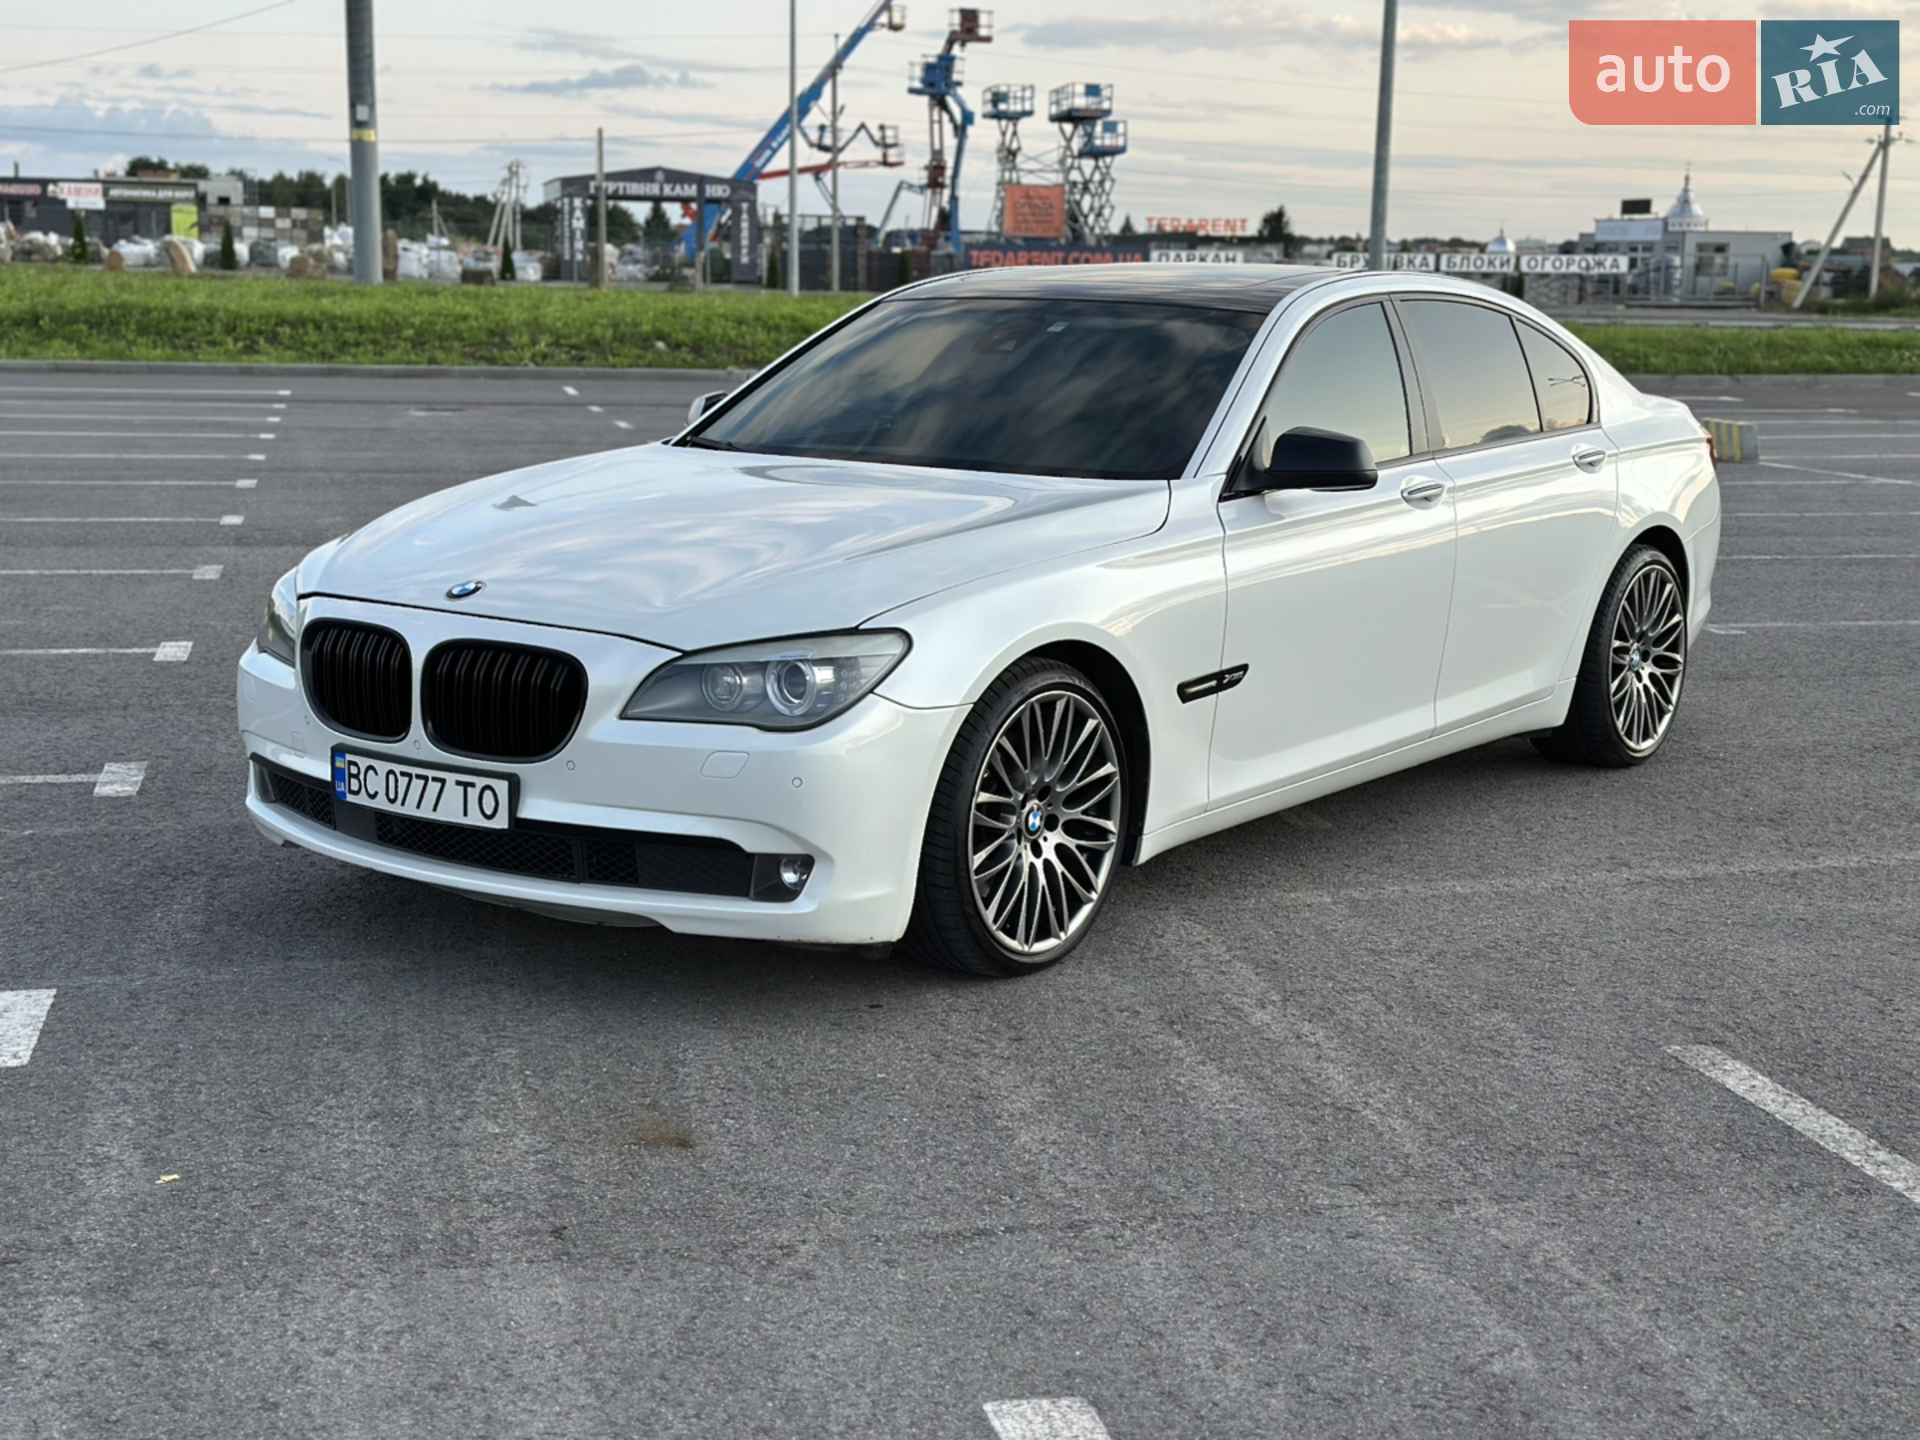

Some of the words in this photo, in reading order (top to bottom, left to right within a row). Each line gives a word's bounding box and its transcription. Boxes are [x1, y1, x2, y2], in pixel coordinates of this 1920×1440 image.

[663, 183, 731, 198] КАМНЮ
[1445, 256, 1512, 270] БЛОКИ
[1527, 256, 1621, 270] ОГОРОЖА
[335, 780, 346, 793] UA
[347, 759, 379, 800] BC
[385, 768, 447, 813] 0777
[455, 780, 500, 821] TO
